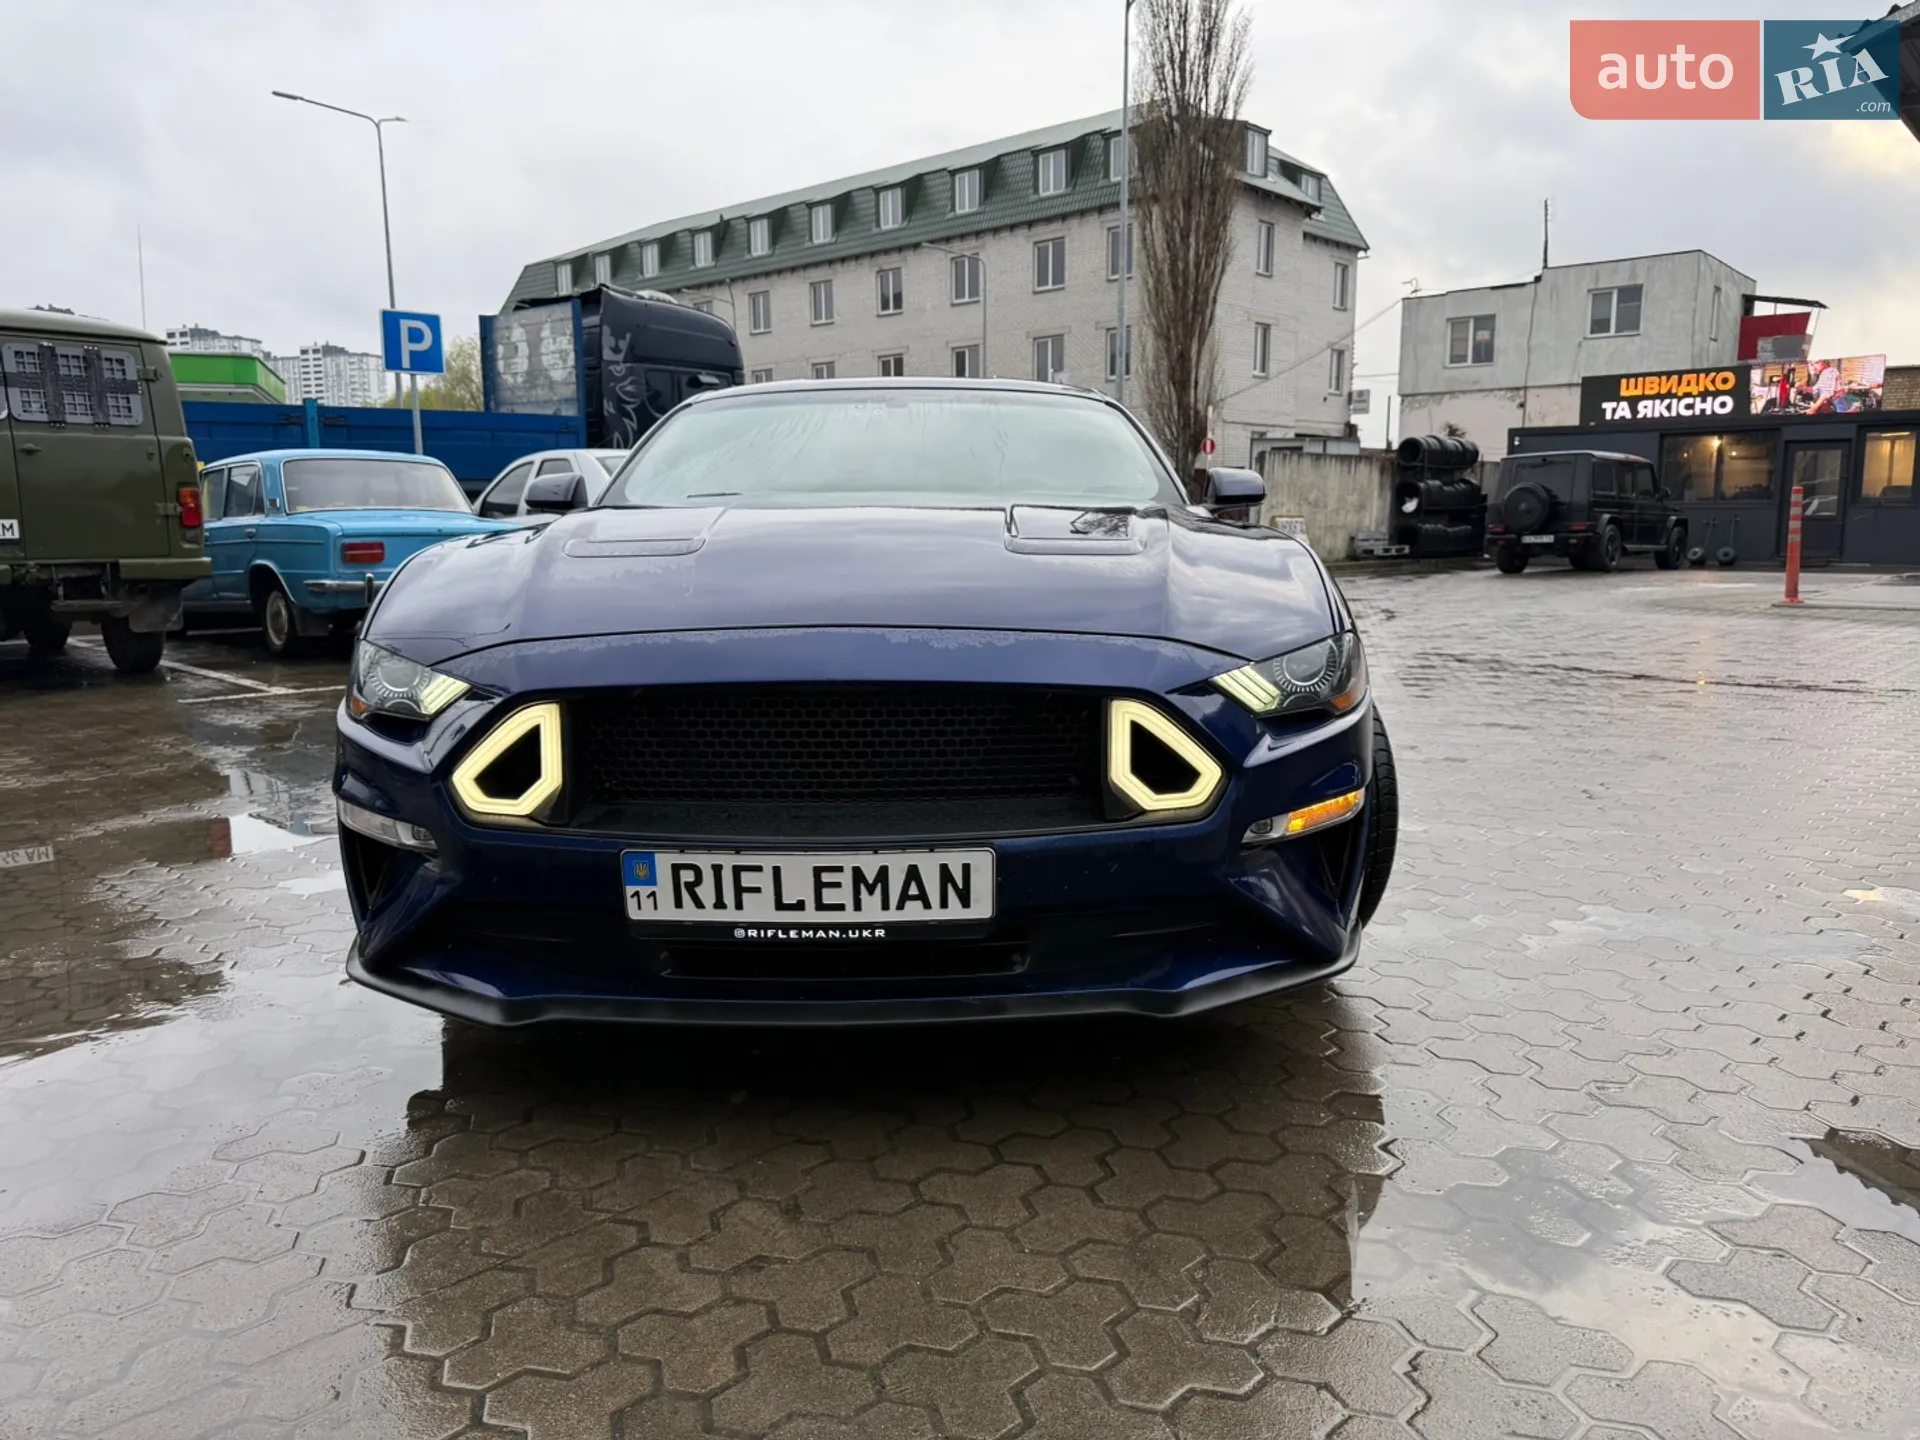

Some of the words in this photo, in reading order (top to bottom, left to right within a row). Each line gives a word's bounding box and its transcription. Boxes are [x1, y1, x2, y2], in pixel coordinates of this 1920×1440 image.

[400, 319, 433, 369] P
[1619, 371, 1736, 397] ШВИДКО
[1601, 401, 1632, 420] ТА
[1637, 395, 1734, 419] ЯКІСНО
[0, 522, 15, 537] M
[630, 890, 658, 911] 11
[670, 862, 972, 912] RIFLEMAN
